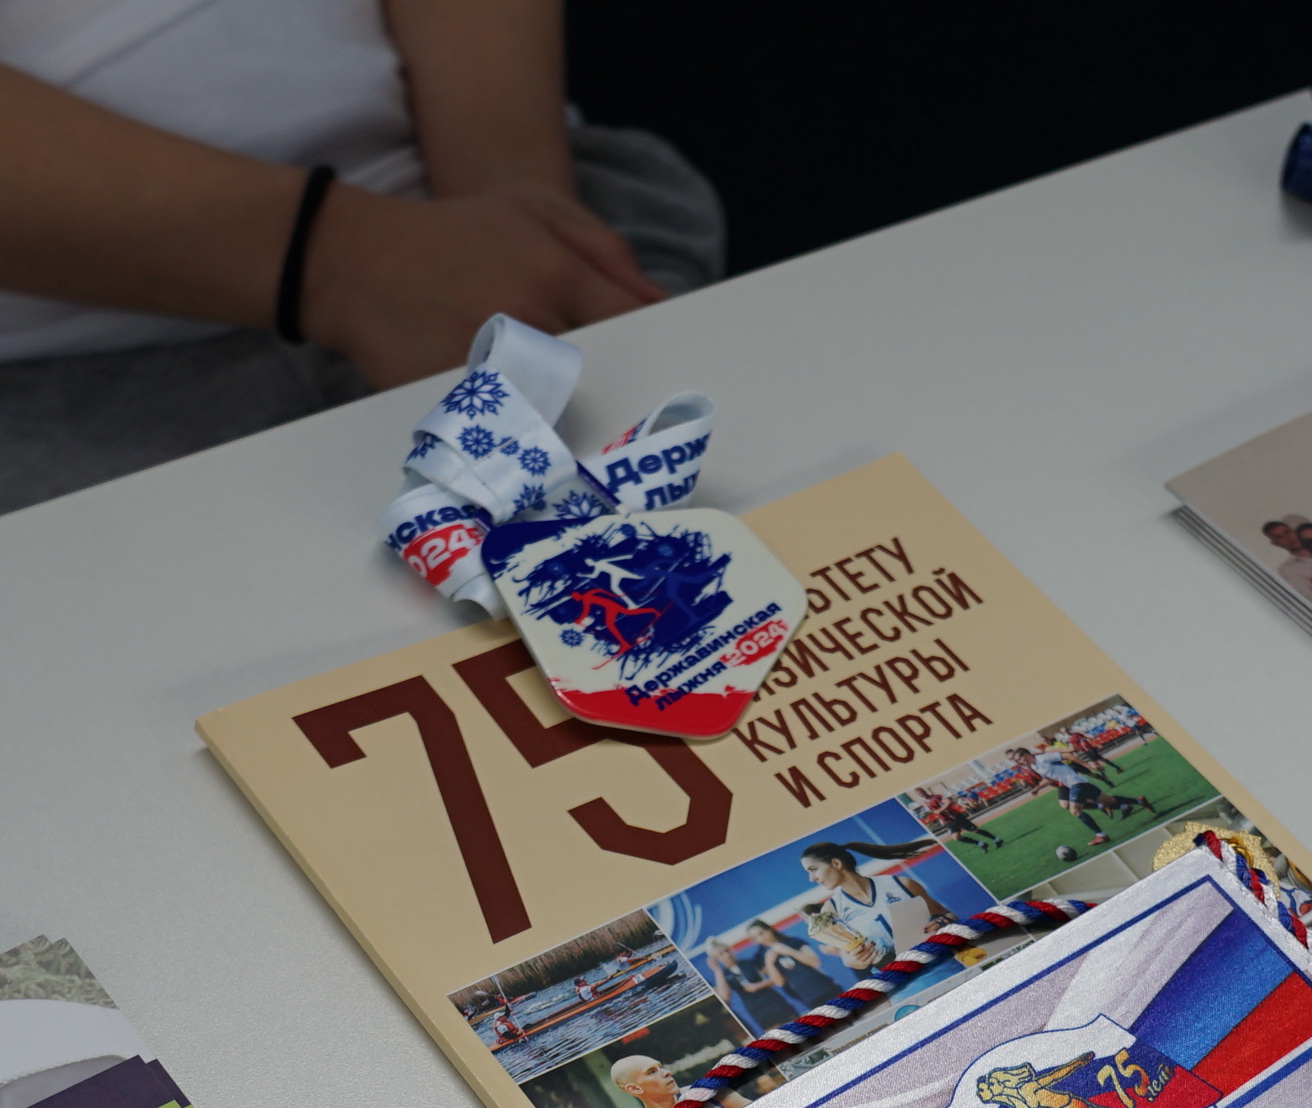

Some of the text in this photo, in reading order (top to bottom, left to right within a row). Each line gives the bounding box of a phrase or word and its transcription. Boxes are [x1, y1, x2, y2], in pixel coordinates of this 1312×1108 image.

[625, 601, 783, 706] Державинская
[654, 619, 786, 712] лыжня 2024
[731, 637, 971, 764] КУЛЬТУРЫ
[291, 636, 734, 945] 75
[774, 692, 994, 810] И СПОРТА
